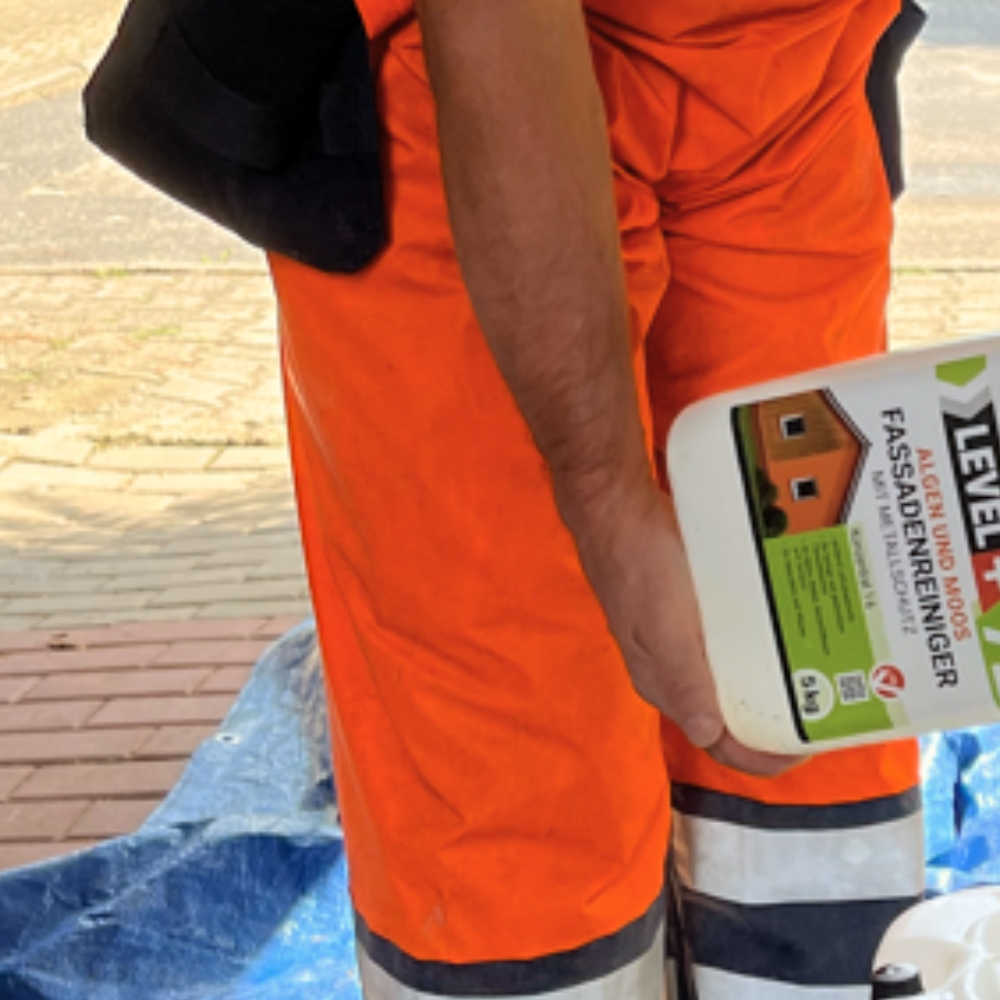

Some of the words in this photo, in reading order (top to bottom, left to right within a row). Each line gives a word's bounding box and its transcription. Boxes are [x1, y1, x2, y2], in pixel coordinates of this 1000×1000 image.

[871, 470, 891, 500] MIT
[916, 447, 946, 520] ALGEN
[879, 505, 918, 635] METALLSCHUTZ
[882, 406, 959, 689] FASSADENREINIGER
[932, 523, 956, 571] UND
[943, 575, 972, 642] MOOS
[802, 675, 817, 688] 5
[802, 689, 820, 714] kg
